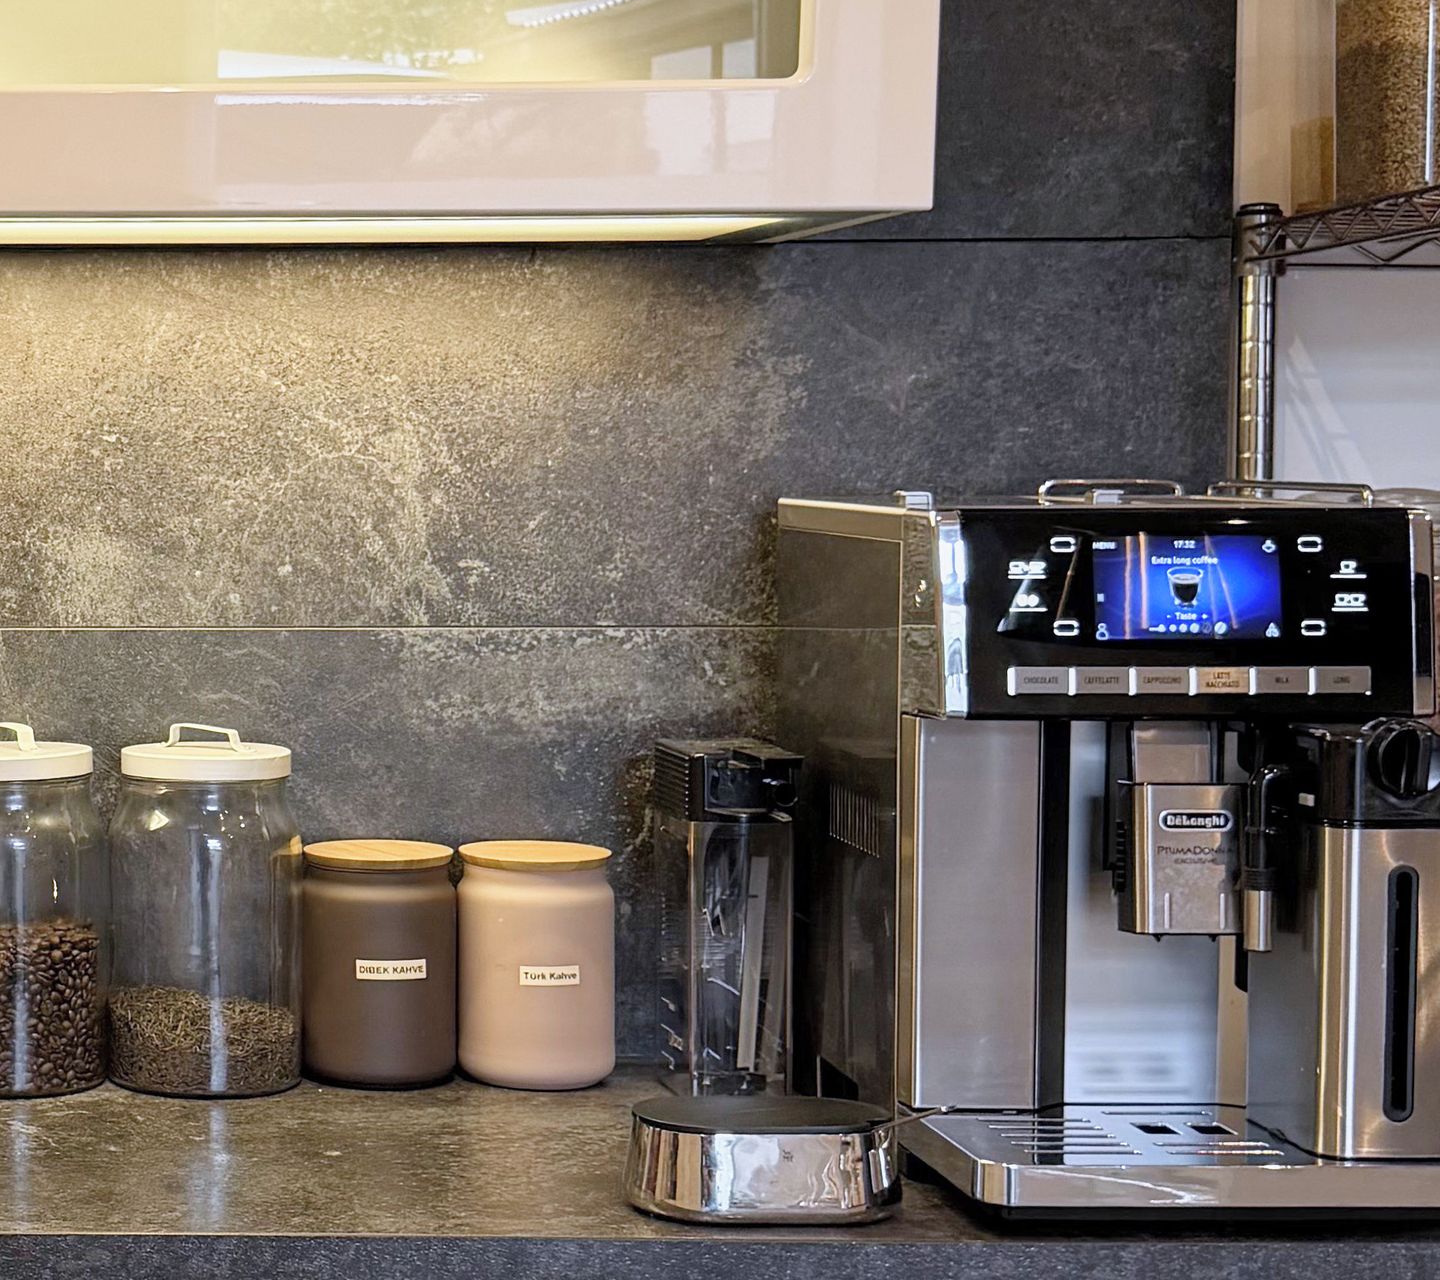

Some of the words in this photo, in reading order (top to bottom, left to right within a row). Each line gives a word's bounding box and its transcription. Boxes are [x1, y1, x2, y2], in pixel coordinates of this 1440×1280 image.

[1092, 541, 1117, 550] MENU
[1151, 556, 1172, 565] Extra
[1173, 556, 1191, 566] long
[1192, 556, 1219, 565] coffee
[1175, 612, 1197, 621] Taste
[392, 965, 424, 975] KAHVE
[549, 971, 578, 980] Kahve
